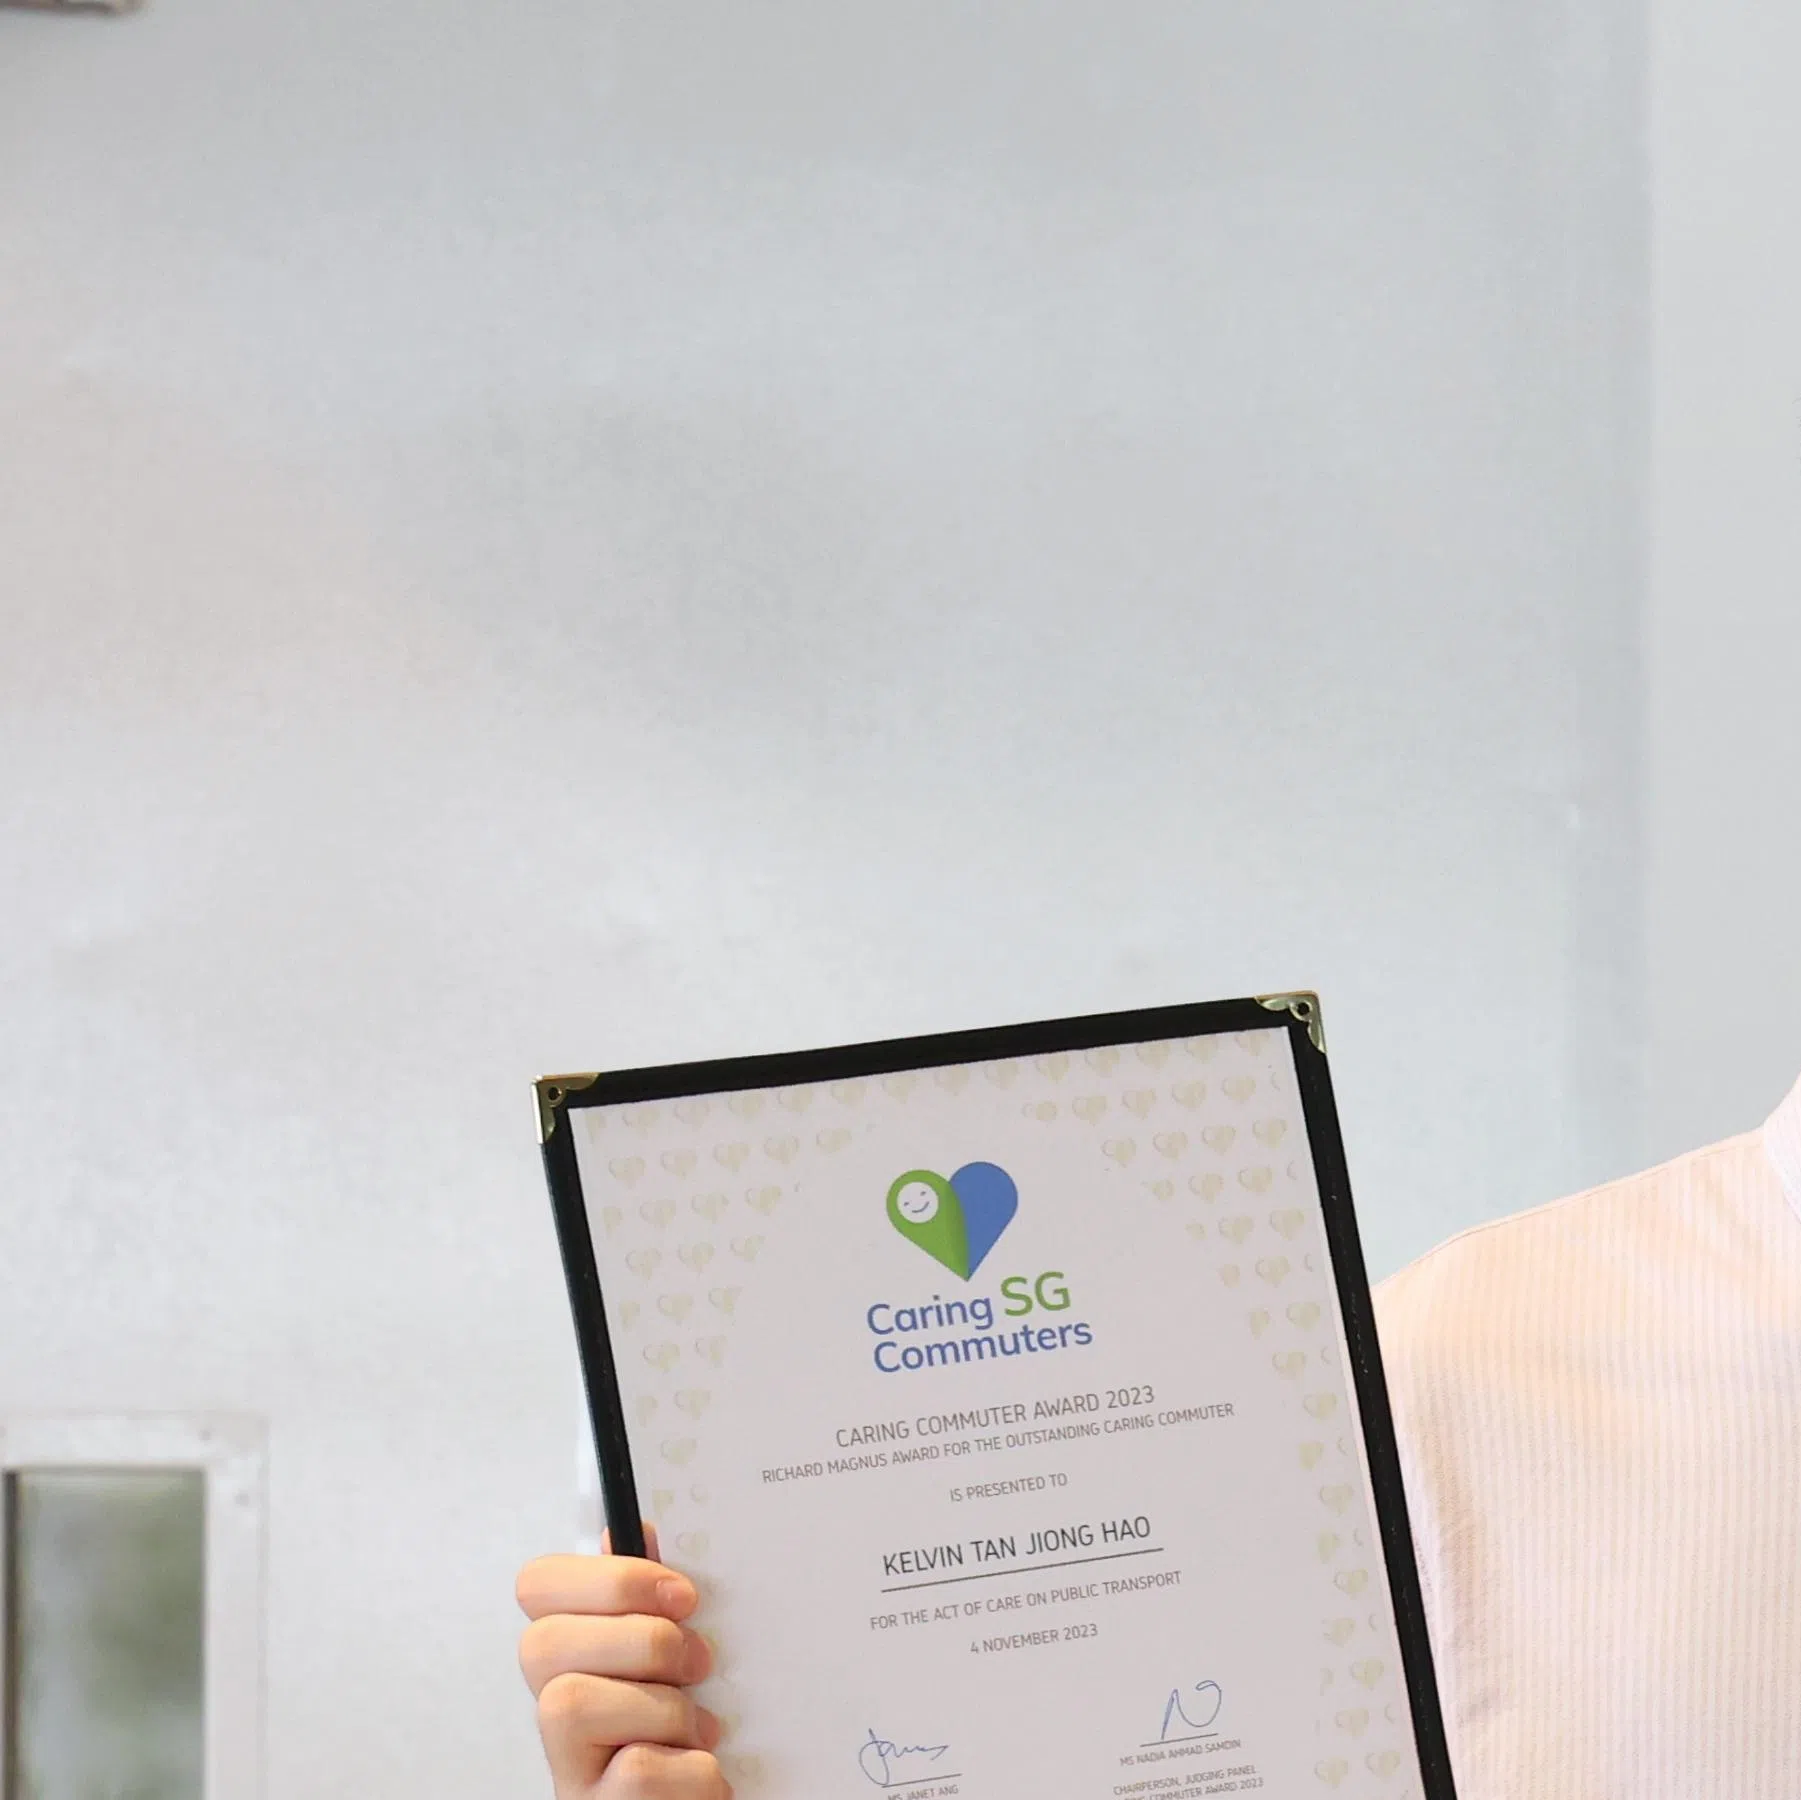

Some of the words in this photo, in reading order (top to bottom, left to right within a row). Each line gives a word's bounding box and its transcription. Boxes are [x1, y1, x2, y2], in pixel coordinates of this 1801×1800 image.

[867, 1295, 993, 1335] Caring
[1001, 1271, 1071, 1316] SG
[874, 1322, 1092, 1372] Commuters
[836, 1420, 909, 1447] CARING
[916, 1404, 1026, 1436] COMMUTER
[1033, 1393, 1099, 1420] AWARD
[1106, 1385, 1155, 1408] 2023
[762, 1462, 823, 1483] RICHARD
[827, 1453, 887, 1474] MAGNUS
[892, 1445, 939, 1465] AWARD
[944, 1440, 970, 1457] FOR
[974, 1436, 1001, 1452] THE
[1006, 1422, 1100, 1448] OUTSTANDING
[1104, 1414, 1153, 1434] CARING
[1158, 1403, 1235, 1426] COMMUTER
[950, 1488, 963, 1502] IS
[967, 1476, 1045, 1500] PRESENTED
[1048, 1472, 1067, 1488] TO
[883, 1543, 964, 1576] KELVIN
[970, 1535, 1016, 1563] TAN
[1025, 1524, 1094, 1556] JIONG
[1101, 1516, 1150, 1543] HAO
[870, 1615, 897, 1630] FOR
[901, 1609, 929, 1625] THE
[933, 1604, 959, 1621] ACT
[964, 1601, 982, 1616] OF
[986, 1596, 1022, 1613] CARE
[1026, 1592, 1047, 1608] ON
[1051, 1584, 1099, 1604] PUBLIC
[1101, 1570, 1182, 1596] TRANSPORT
[970, 1641, 979, 1654] 4
[983, 1629, 1059, 1653] NOVEMBER
[1062, 1623, 1098, 1641] 2023
[1119, 1757, 1134, 1766] MS
[1136, 1751, 1167, 1764] NADIA
[1185, 1769, 1224, 1785] JUDGING
[1227, 1765, 1256, 1777] PANEL
[939, 1784, 959, 1797] ANG
[1205, 1782, 1237, 1795] AWARD
[1240, 1777, 1264, 1790] 2023
